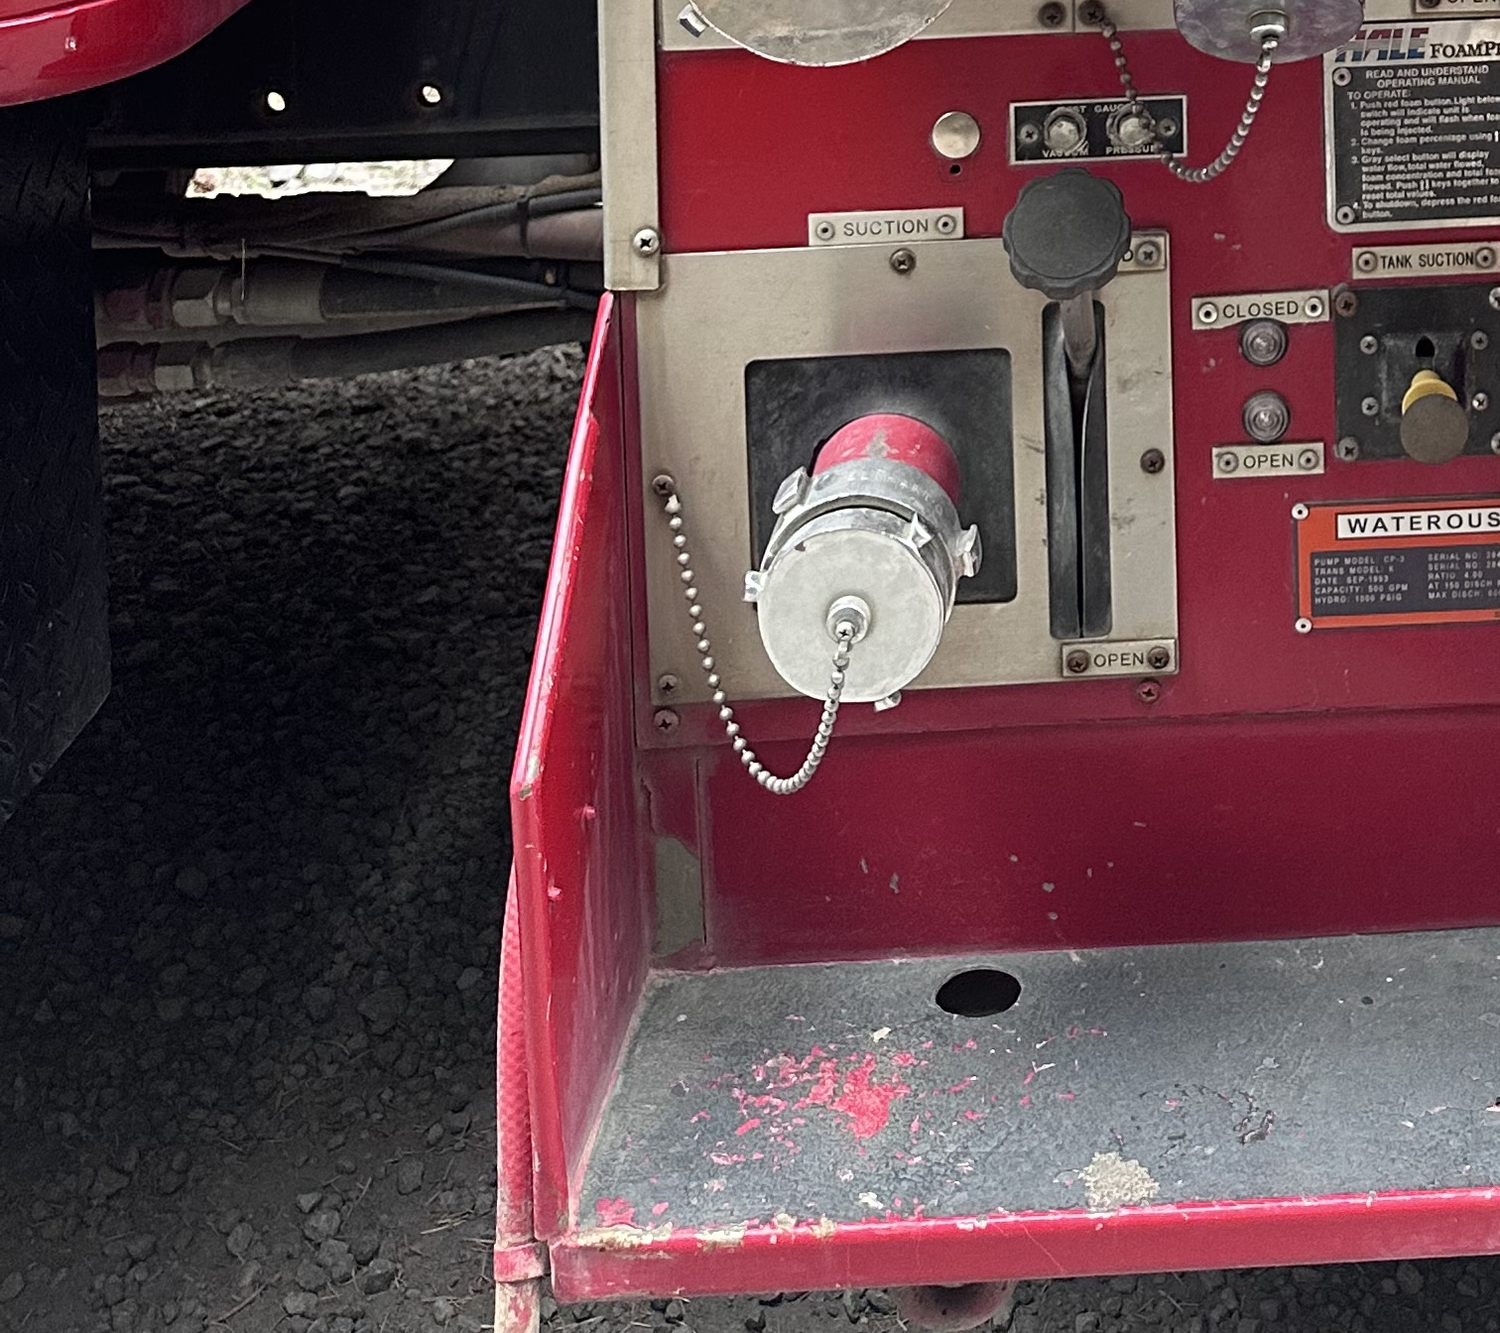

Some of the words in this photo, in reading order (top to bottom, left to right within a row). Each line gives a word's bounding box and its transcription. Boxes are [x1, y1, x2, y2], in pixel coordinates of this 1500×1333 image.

[1366, 70, 1394, 79] READ
[1397, 68, 1419, 77] AND
[1421, 65, 1489, 76] UNDERSTAND
[1377, 78, 1435, 88] OPERATING
[1438, 75, 1481, 85] MANUAL
[1347, 91, 1361, 100] TO
[1360, 100, 1382, 109] Push
[1384, 100, 1399, 108] red
[1401, 99, 1422, 107] foam
[1361, 109, 1388, 118] switch
[1390, 109, 1405, 117] will
[1407, 107, 1441, 116] indicate
[1360, 118, 1401, 129] operating
[1404, 116, 1420, 125] and
[1421, 116, 1437, 124] will
[1438, 114, 1460, 124] flash
[1461, 114, 1485, 123] when
[1370, 127, 1395, 137] being
[1361, 137, 1394, 146] Change
[1396, 136, 1418, 144] foam
[1419, 134, 1467, 145] percentage
[1469, 133, 1492, 142] using
[1361, 155, 1382, 164] Gray
[1384, 154, 1410, 163] select
[1412, 153, 1440, 161] button
[1442, 151, 1457, 159] will
[1459, 150, 1490, 160] display
[1362, 165, 1386, 173] water
[1428, 161, 1452, 169] water
[1362, 174, 1384, 182] foam
[1385, 171, 1444, 181] concentration
[1446, 169, 1462, 178] and
[1464, 169, 1483, 177] total
[1396, 181, 1418, 190] Push
[1453, 178, 1489, 188] together
[1421, 198, 1455, 208] depress
[1457, 196, 1471, 205] the
[1473, 195, 1488, 204] red
[843, 219, 929, 237] SUCTION
[1380, 255, 1413, 269] TANK
[1418, 251, 1474, 268] SUCTION
[1222, 301, 1299, 318] CLOSED
[1243, 454, 1294, 469] OPEN
[1314, 558, 1340, 566] PUMP
[1428, 553, 1460, 561] SERIAL
[1314, 567, 1344, 575] TRANS
[1428, 562, 1460, 571] SERIAL
[1388, 583, 1409, 592] GPM
[1428, 582, 1440, 590] AT
[1464, 579, 1493, 589] DISCH
[1380, 593, 1402, 602] PSIG
[1428, 591, 1447, 599] MAX
[1094, 652, 1144, 667] OPEN
